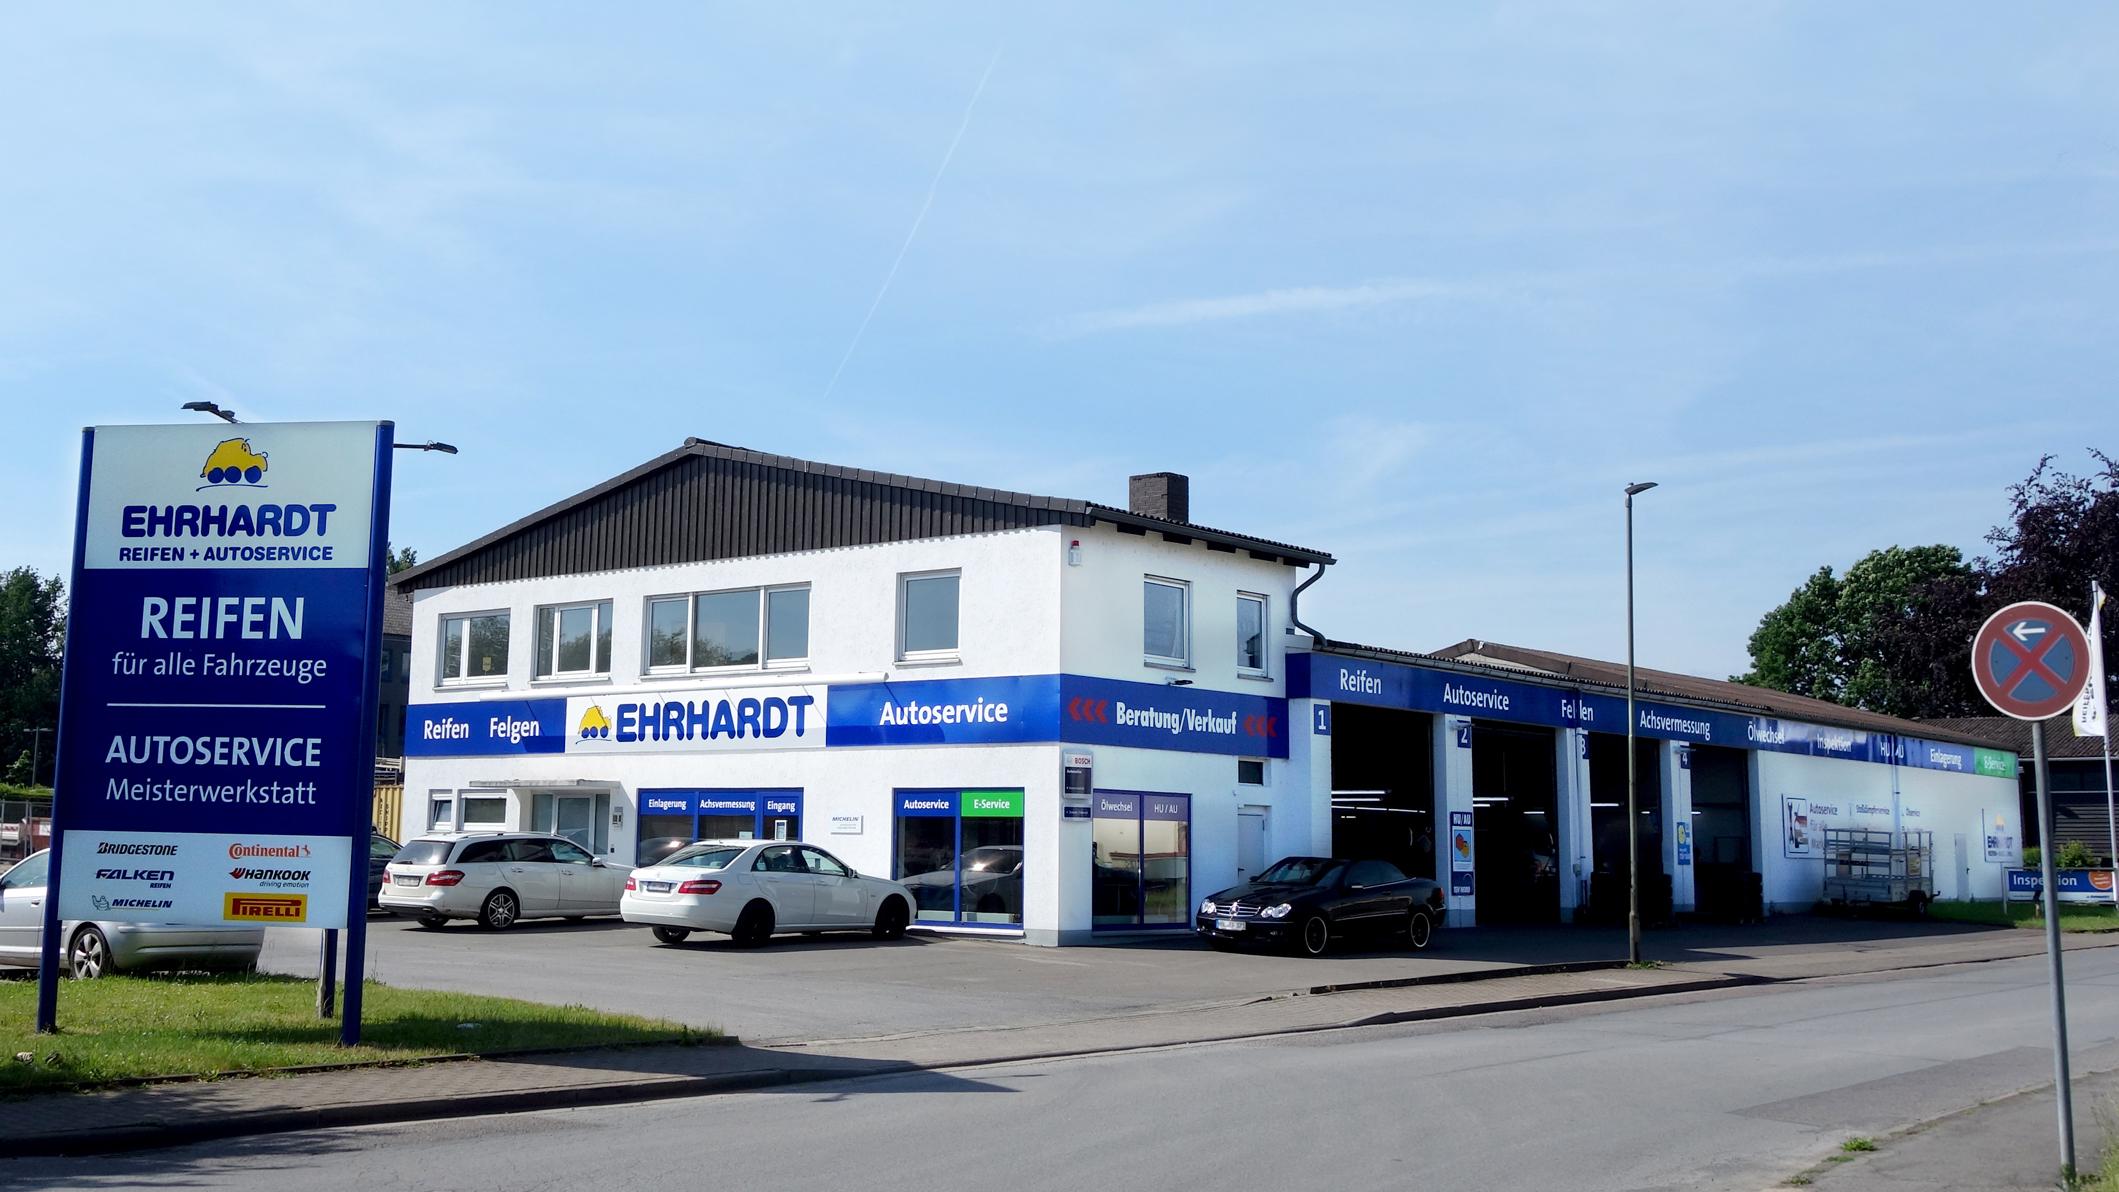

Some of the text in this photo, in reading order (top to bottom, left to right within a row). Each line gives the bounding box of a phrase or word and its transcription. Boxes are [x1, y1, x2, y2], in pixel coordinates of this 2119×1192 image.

[121, 504, 337, 538] EHRHARDT
[119, 546, 334, 561] REIFEN + AUTOSERVICE
[140, 596, 305, 640] REIFEN
[112, 651, 328, 684] für alle Fahrzeuge
[879, 696, 1009, 726] Autoservice
[1340, 668, 1382, 695] Reifen
[1443, 682, 1510, 711] Autoservice
[1639, 710, 1711, 742] Achsvermessung
[1747, 721, 1785, 745] Ölwechsel
[616, 694, 815, 743] EHRHARDT
[1116, 701, 1237, 735] Beratung/Verkauf
[1318, 710, 1327, 730] 1
[423, 715, 540, 744] Reifen Felgen
[1460, 728, 1468, 744] 2
[105, 735, 322, 767] AUTOSERVICE
[1682, 752, 1688, 765] 4
[106, 778, 317, 805] Meisterwerkstatt
[648, 799, 687, 810] Einlagerung
[700, 799, 756, 811] Achsvermessung
[767, 801, 796, 812] Eingang
[903, 799, 950, 809] Autoservice
[973, 799, 1010, 809] E-Service
[1100, 799, 1133, 812] Ölwechsel
[1154, 803, 1164, 814] HU
[1169, 804, 1178, 814] AU
[96, 842, 179, 856] BRIDGESTONE
[229, 843, 300, 859] Continental
[96, 869, 176, 881] FALKEN
[2013, 874, 2078, 889] Inspeion
[259, 881, 281, 889] driving
[111, 899, 173, 908] MICHELIN
[232, 898, 302, 917] PIRELLI
